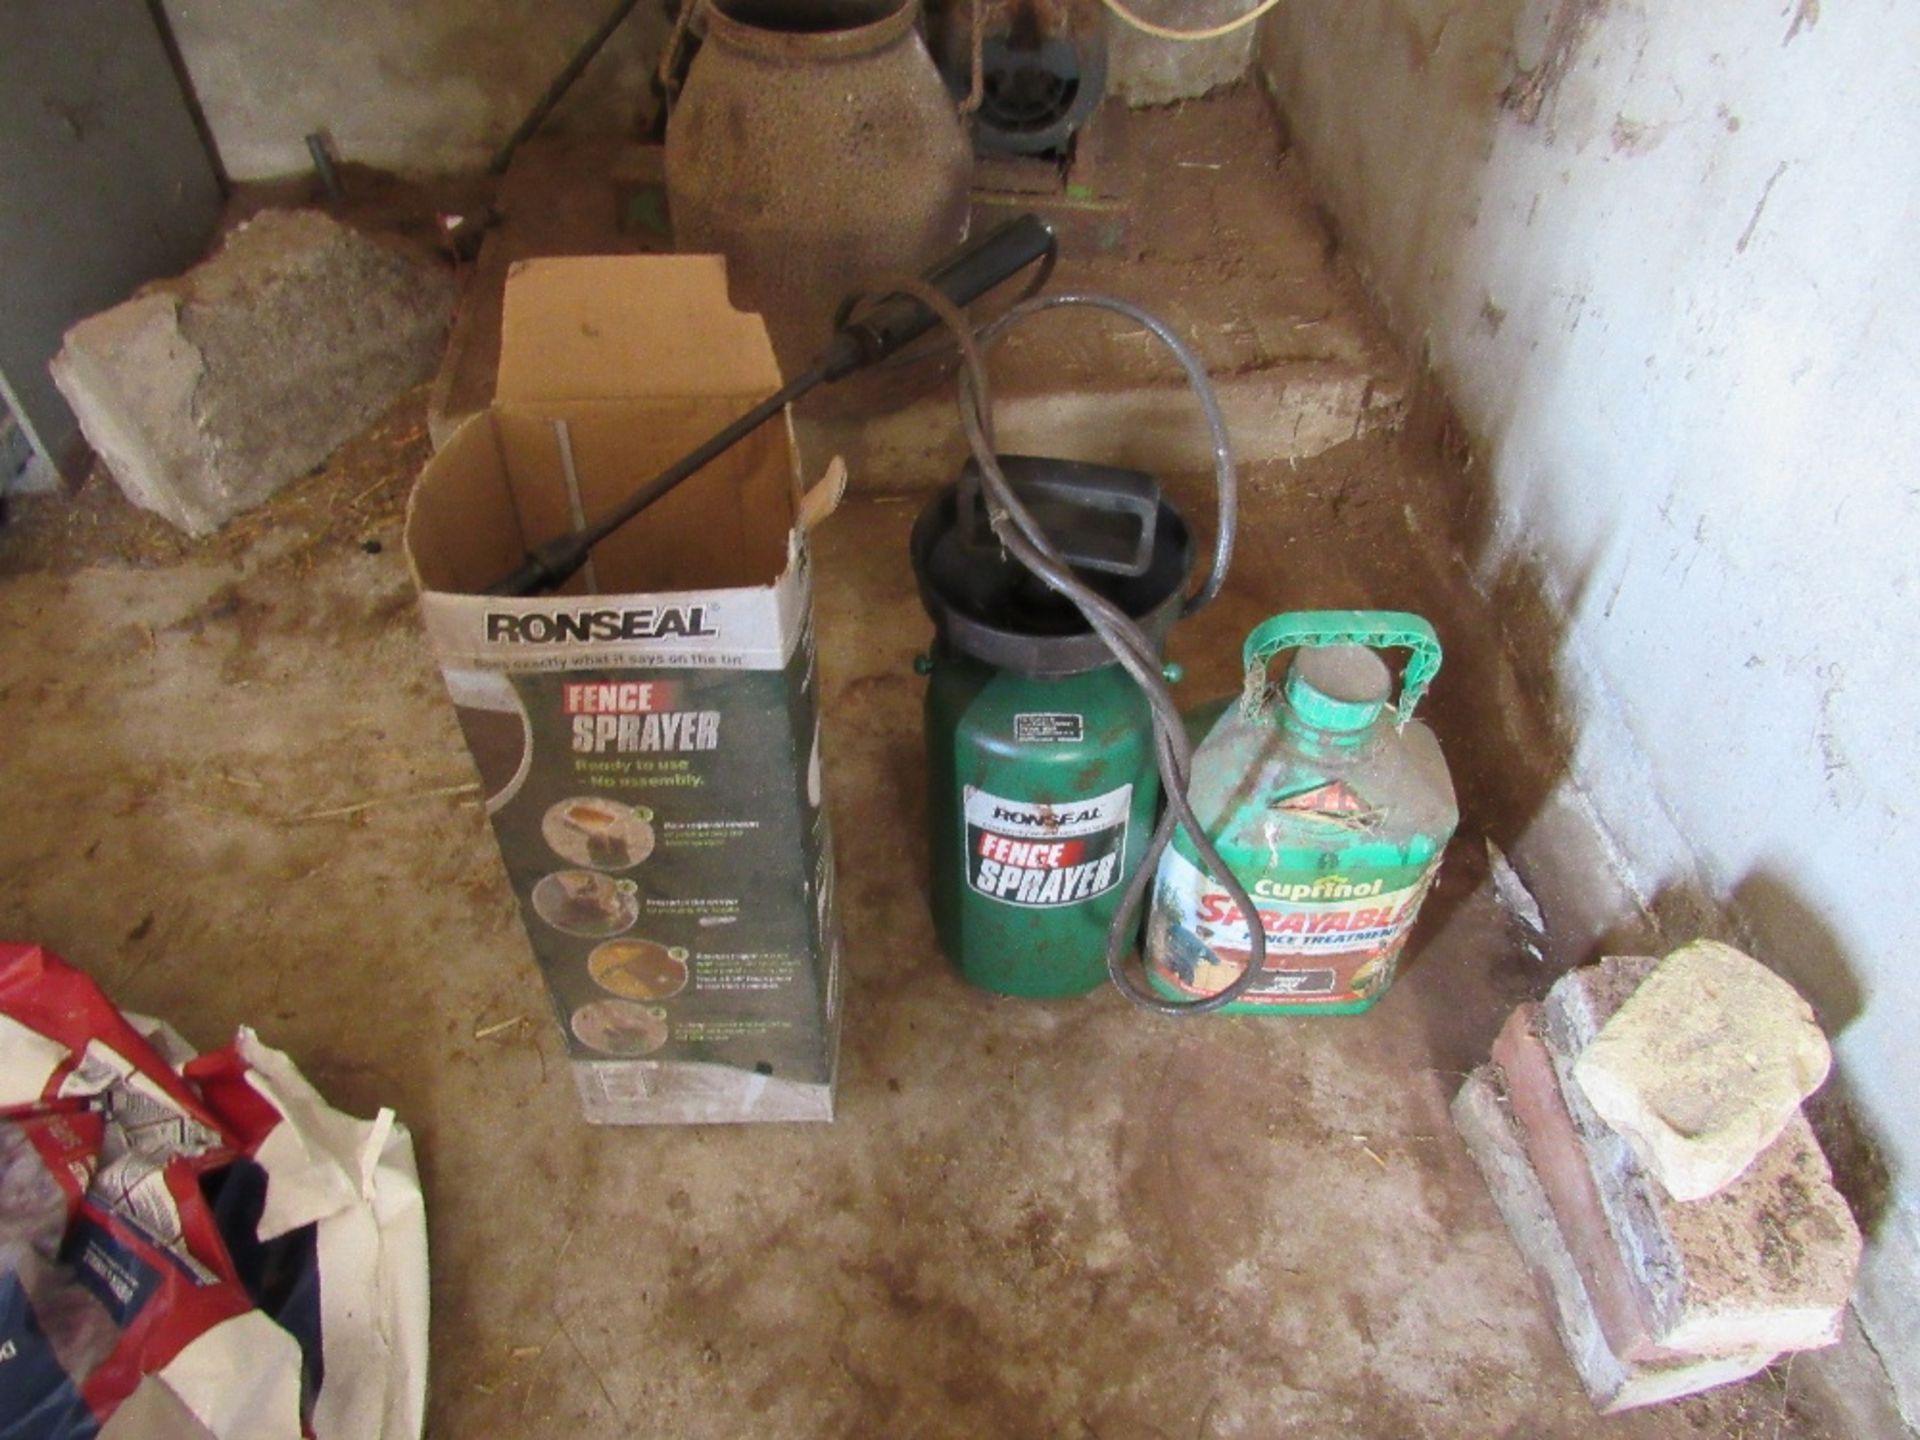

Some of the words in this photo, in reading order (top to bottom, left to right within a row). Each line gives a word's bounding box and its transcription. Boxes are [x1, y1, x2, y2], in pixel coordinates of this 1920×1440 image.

[485, 606, 718, 643] RONSEAL
[571, 653, 611, 666] what
[613, 653, 624, 665] it
[628, 655, 665, 666] says
[670, 655, 688, 665] on
[691, 653, 717, 665] the
[568, 683, 654, 713] FENCE
[571, 710, 721, 753] SPRAYER
[575, 758, 633, 773] Ready
[636, 759, 655, 771] to
[658, 759, 690, 771] use
[591, 775, 615, 787] No
[981, 832, 1066, 868] FENCE
[976, 851, 1118, 904] SPRAYER
[1254, 878, 1383, 901] Cuprinol
[1242, 931, 1299, 946] FNCE
